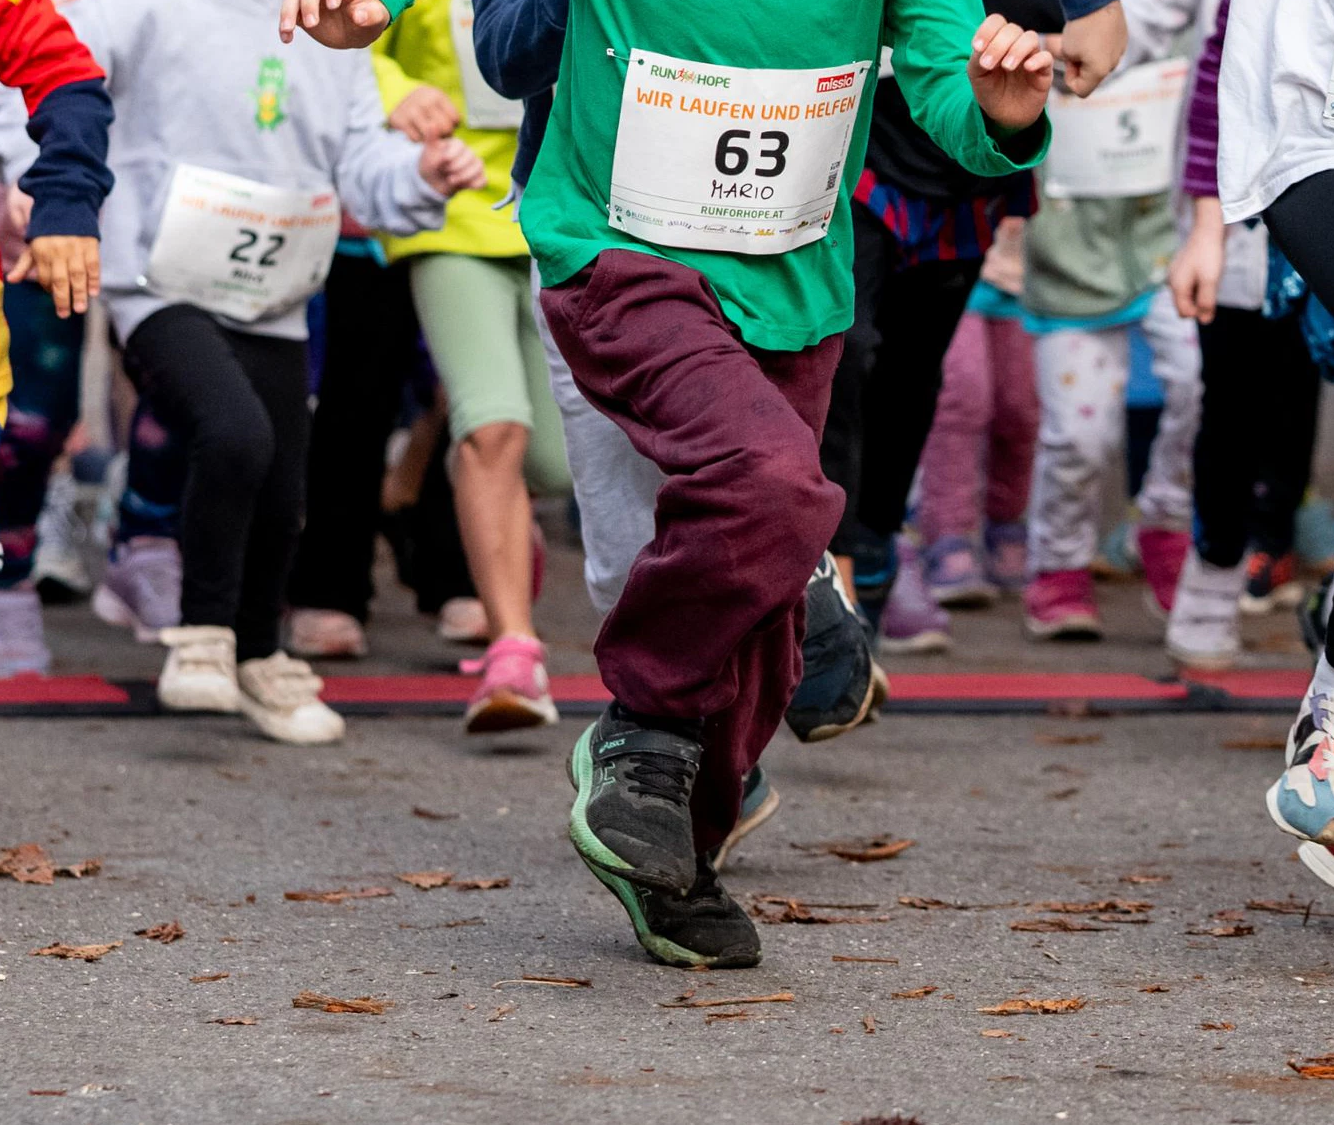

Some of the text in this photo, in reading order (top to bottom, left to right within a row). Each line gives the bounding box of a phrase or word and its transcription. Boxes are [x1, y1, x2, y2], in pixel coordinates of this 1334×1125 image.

[650, 65, 731, 88] RUN HOPE
[818, 75, 854, 92] missio
[636, 87, 856, 120] WIR LAUFEN UND HELFEN
[714, 129, 790, 177] 63
[710, 180, 774, 200] MARIO
[700, 206, 783, 219] RUNFORHOPE.AT
[229, 227, 286, 267] 22
